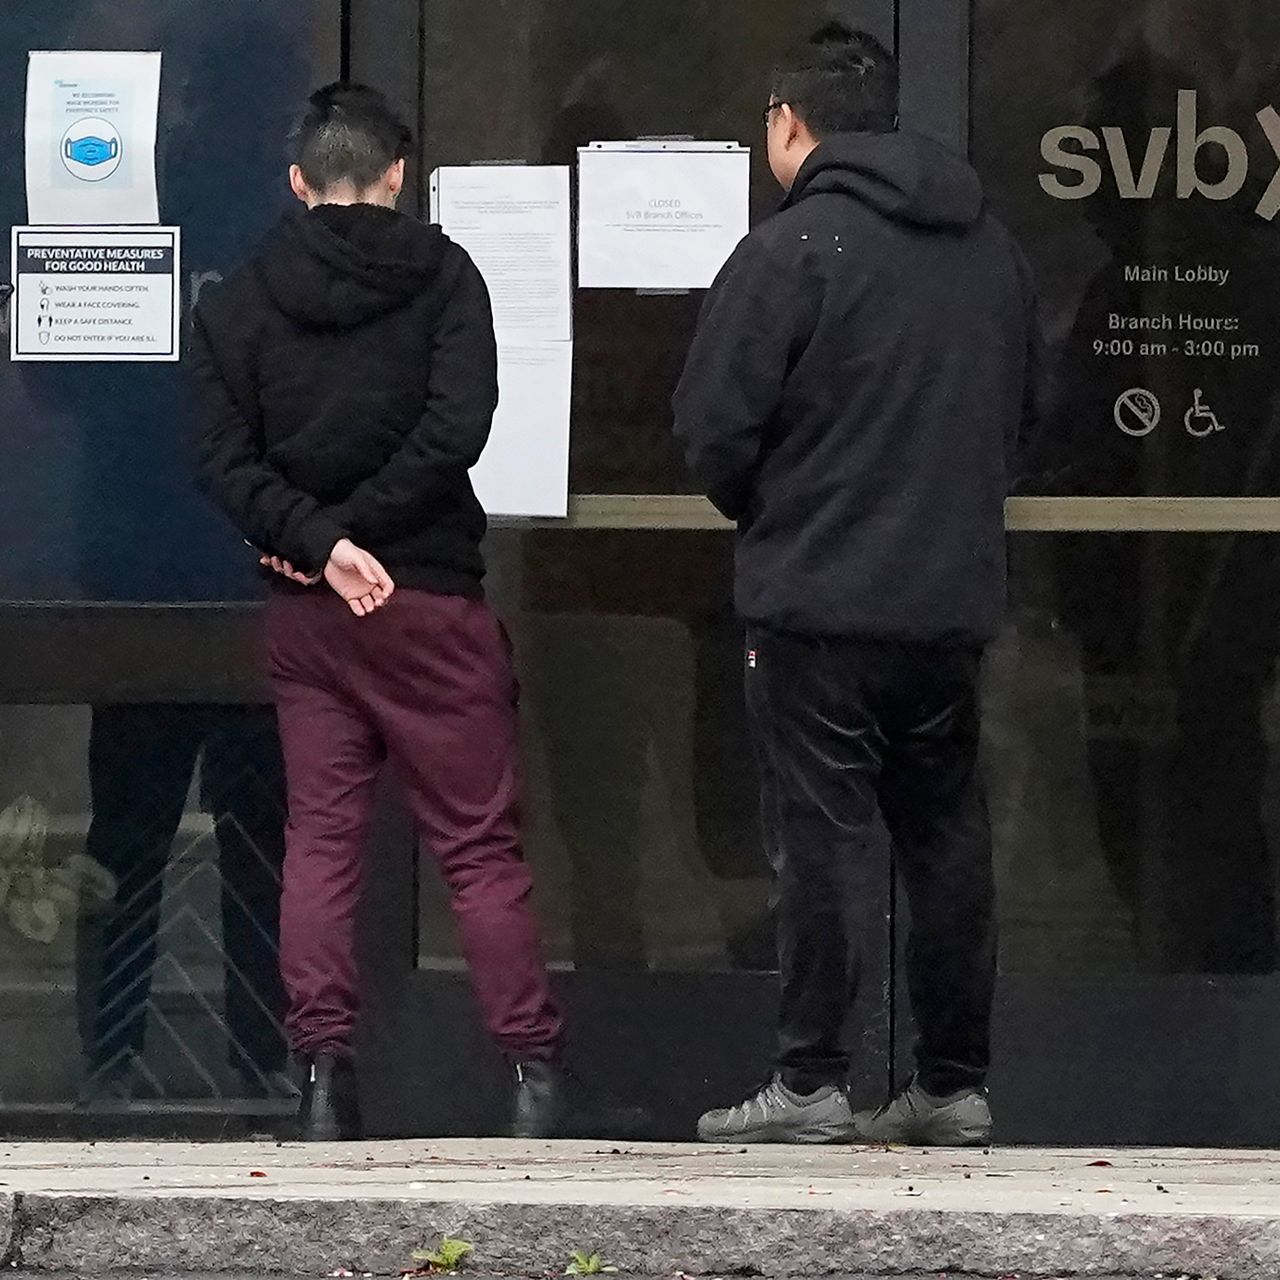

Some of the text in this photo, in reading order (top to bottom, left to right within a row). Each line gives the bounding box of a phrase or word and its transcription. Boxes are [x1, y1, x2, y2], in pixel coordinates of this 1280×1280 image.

[1037, 89, 1249, 201] svb
[648, 199, 681, 208] CLOSED
[27, 248, 164, 260] PREVENTATIVE MEASURES
[44, 260, 146, 272] FOR GOOD HEALTH
[1124, 265, 1230, 286] Main Lobby
[54, 284, 77, 293] WASH
[77, 284, 97, 293] YOUR
[54, 301, 76, 309] WEAR
[83, 301, 101, 309] FACE
[1108, 313, 1239, 331] Branch Hours:
[66, 334, 82, 342] NOT
[1092, 340, 1134, 357] 9:00
[1139, 343, 1167, 357] am
[1184, 340, 1225, 357] 3:00
[1231, 343, 1260, 360] pm
